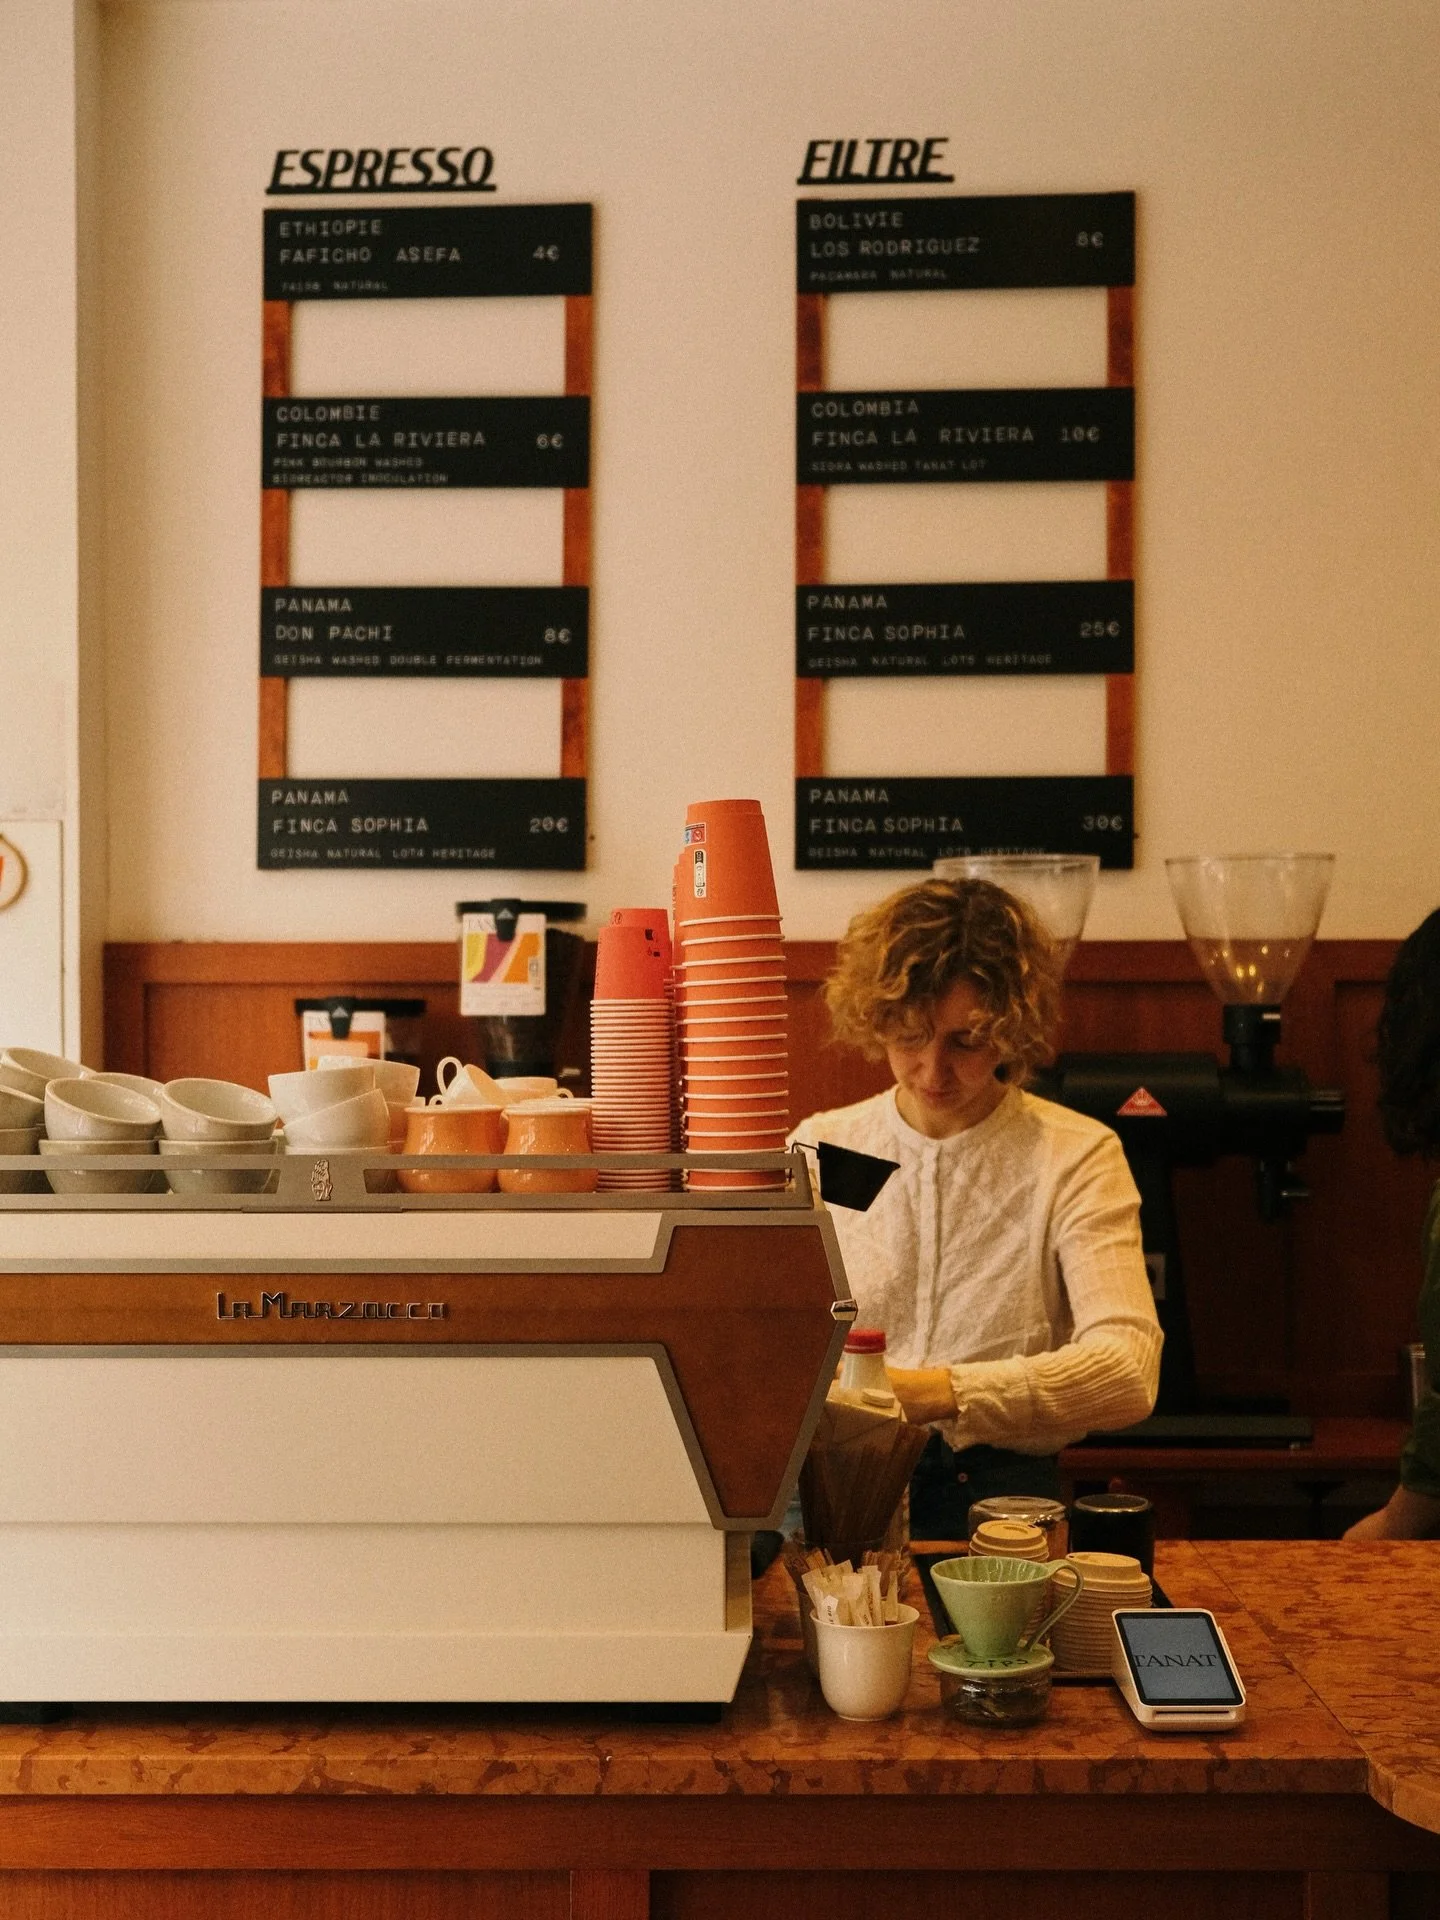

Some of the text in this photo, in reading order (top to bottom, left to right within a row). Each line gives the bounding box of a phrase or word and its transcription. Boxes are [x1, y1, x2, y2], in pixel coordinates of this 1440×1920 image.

[799, 137, 951, 182] FILTRE
[269, 147, 495, 191] ESPRESSO
[279, 219, 382, 238] ETHIOPIE
[809, 212, 904, 231] BOLIVIE
[279, 245, 560, 265] FAFICHO ASEFA 4€
[810, 241, 850, 259] LOS
[859, 236, 981, 256] RODRIGUEZ
[891, 269, 947, 280] NATURAL
[334, 280, 388, 291] NATURAL
[276, 405, 381, 423] COLOMBIE
[811, 399, 920, 418] COLOMBIA
[277, 431, 564, 449] FINCA LA RIVIERA 6€
[811, 427, 1101, 447] FINCA LA RIVIERA 10€
[273, 457, 423, 468] PINK BOURBON WASHED
[859, 460, 908, 471] WASHED
[915, 460, 956, 470] TANAT
[962, 459, 987, 470] LOT
[272, 472, 449, 484] BIOREACTOR INOCULATION
[274, 597, 352, 613] PANAMA
[808, 594, 888, 609] PANAMA
[275, 625, 571, 643] DON PACHI 8€
[808, 622, 1119, 642] FINCA SOPHIA 25€
[274, 655, 543, 666] GEISHA WASHED DOUBLE FERMENTATION
[808, 658, 858, 669] GEISHA
[871, 656, 928, 667] NATURAL
[986, 654, 1052, 665] HERITAGE
[271, 789, 350, 806] PANAMA
[809, 788, 890, 804] PANAMA
[273, 817, 569, 834] FINCA SOPHIA 20€
[809, 815, 1123, 834] FINCA SOPHIA 30€
[271, 848, 318, 859] GEISHA
[327, 848, 382, 859] NATURAL
[432, 848, 496, 859] HERITAGE
[808, 847, 858, 858] GEISHA
[869, 847, 928, 858] NATURAL
[1133, 1654, 1217, 1668] TANAT
